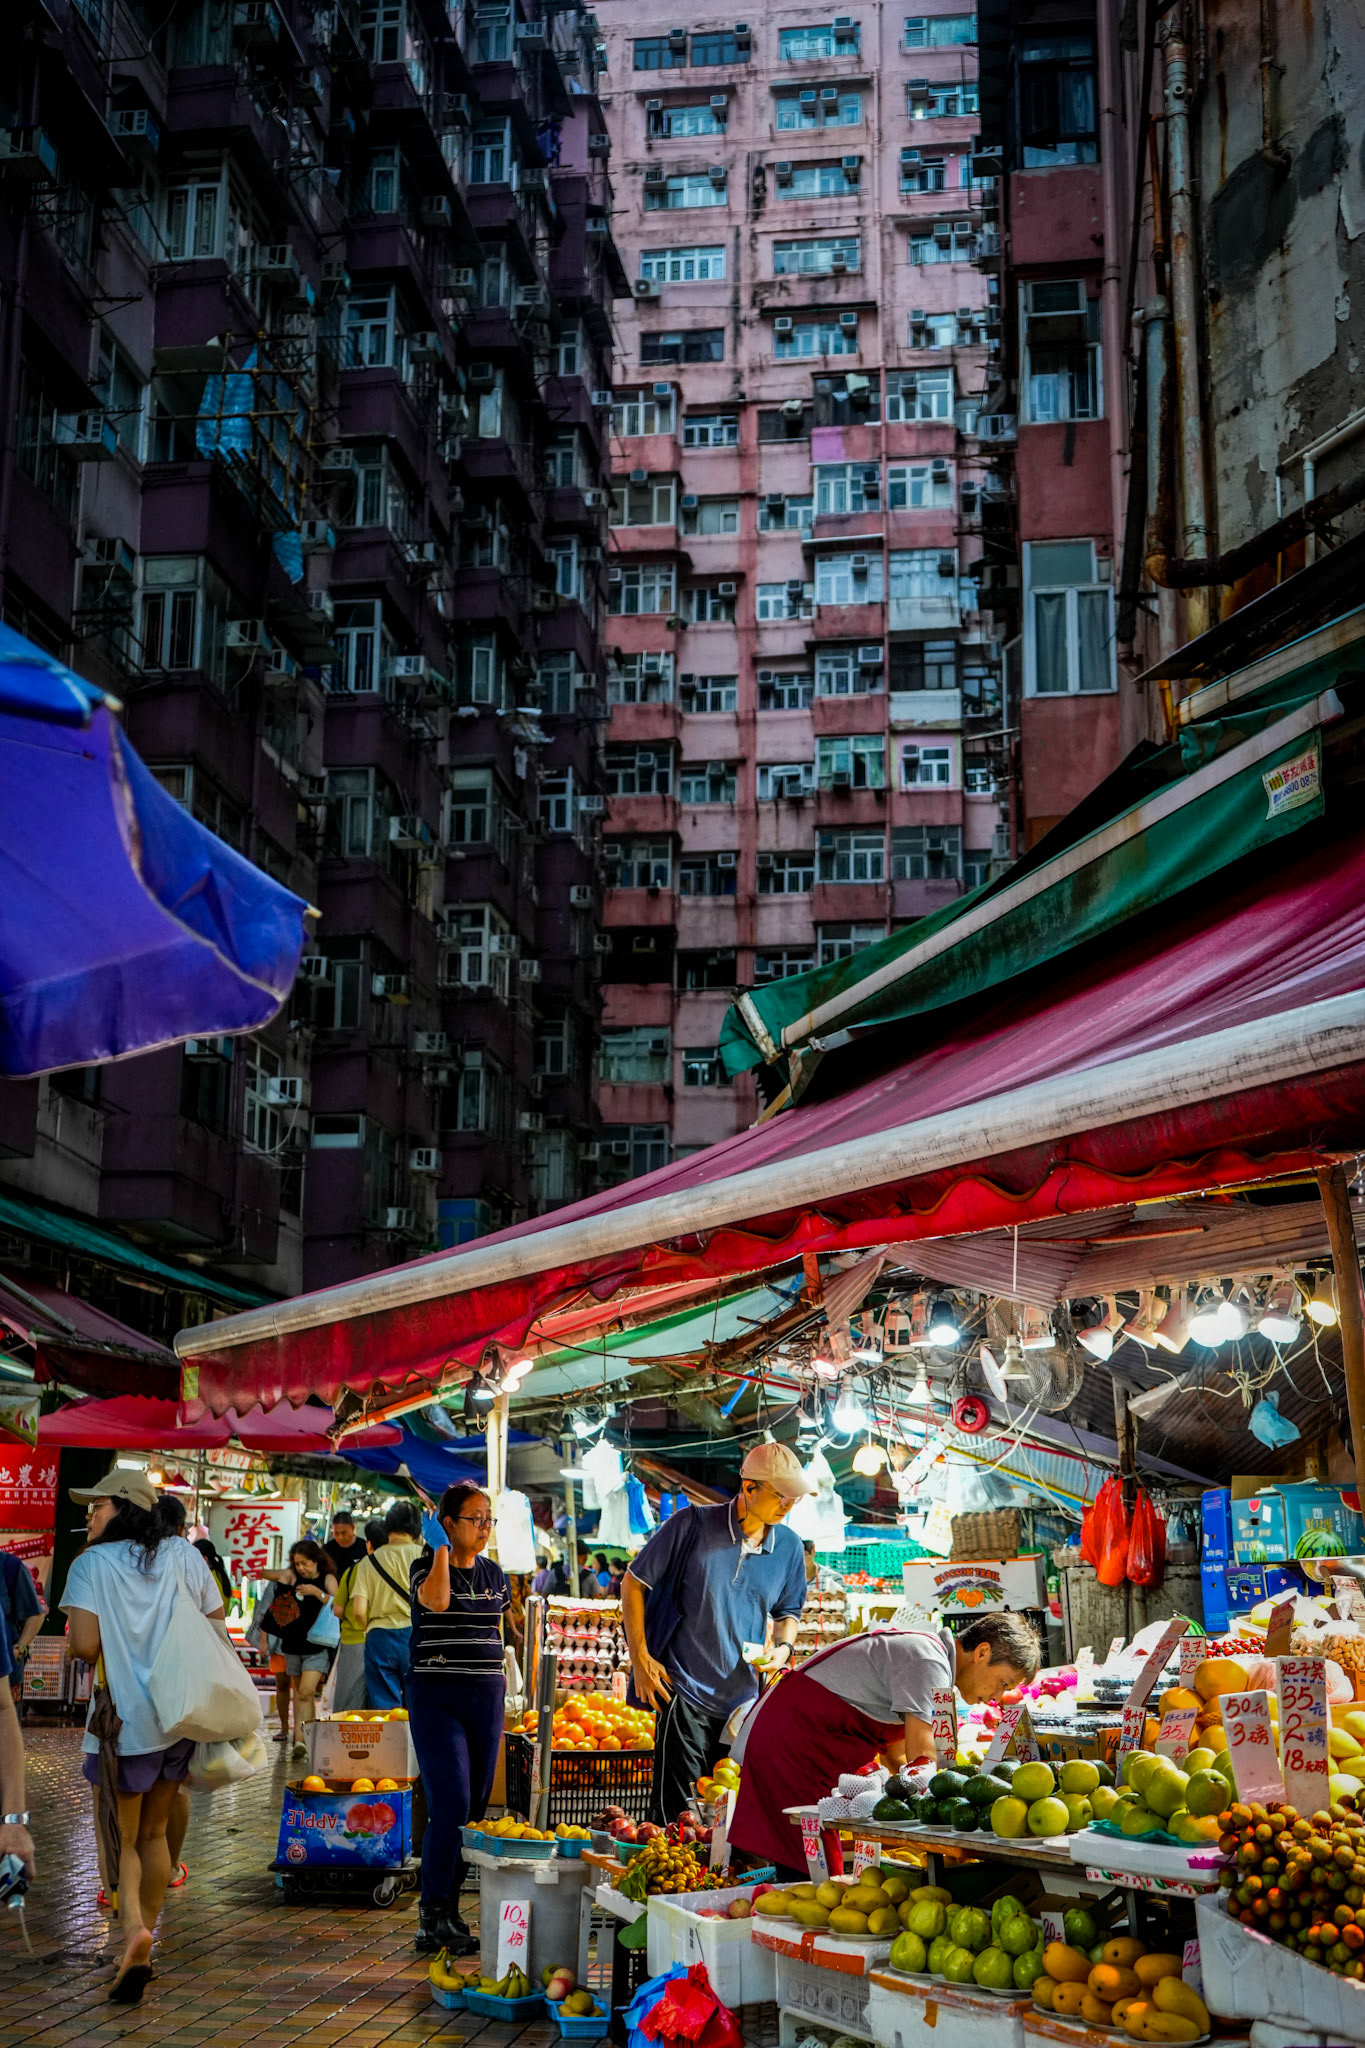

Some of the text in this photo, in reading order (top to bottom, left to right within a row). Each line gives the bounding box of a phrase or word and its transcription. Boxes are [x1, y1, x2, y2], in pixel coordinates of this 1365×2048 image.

[934, 1567, 1001, 1587] BLOSSOM TRAIL
[1179, 1660, 1197, 1675] 25
[1280, 1661, 1324, 1681] 妃子笑
[1225, 1697, 1267, 1719] 50元
[1282, 1685, 1326, 1716] 35元
[341, 1732, 380, 1744] ORANGES
[1158, 1724, 1188, 1741] 35元
[1232, 1722, 1269, 1746] 3磅
[1284, 1713, 1326, 1748] 2磅
[287, 1809, 339, 1829] APPLE
[504, 1904, 528, 1929] 10元
[507, 1931, 525, 1947] 份
